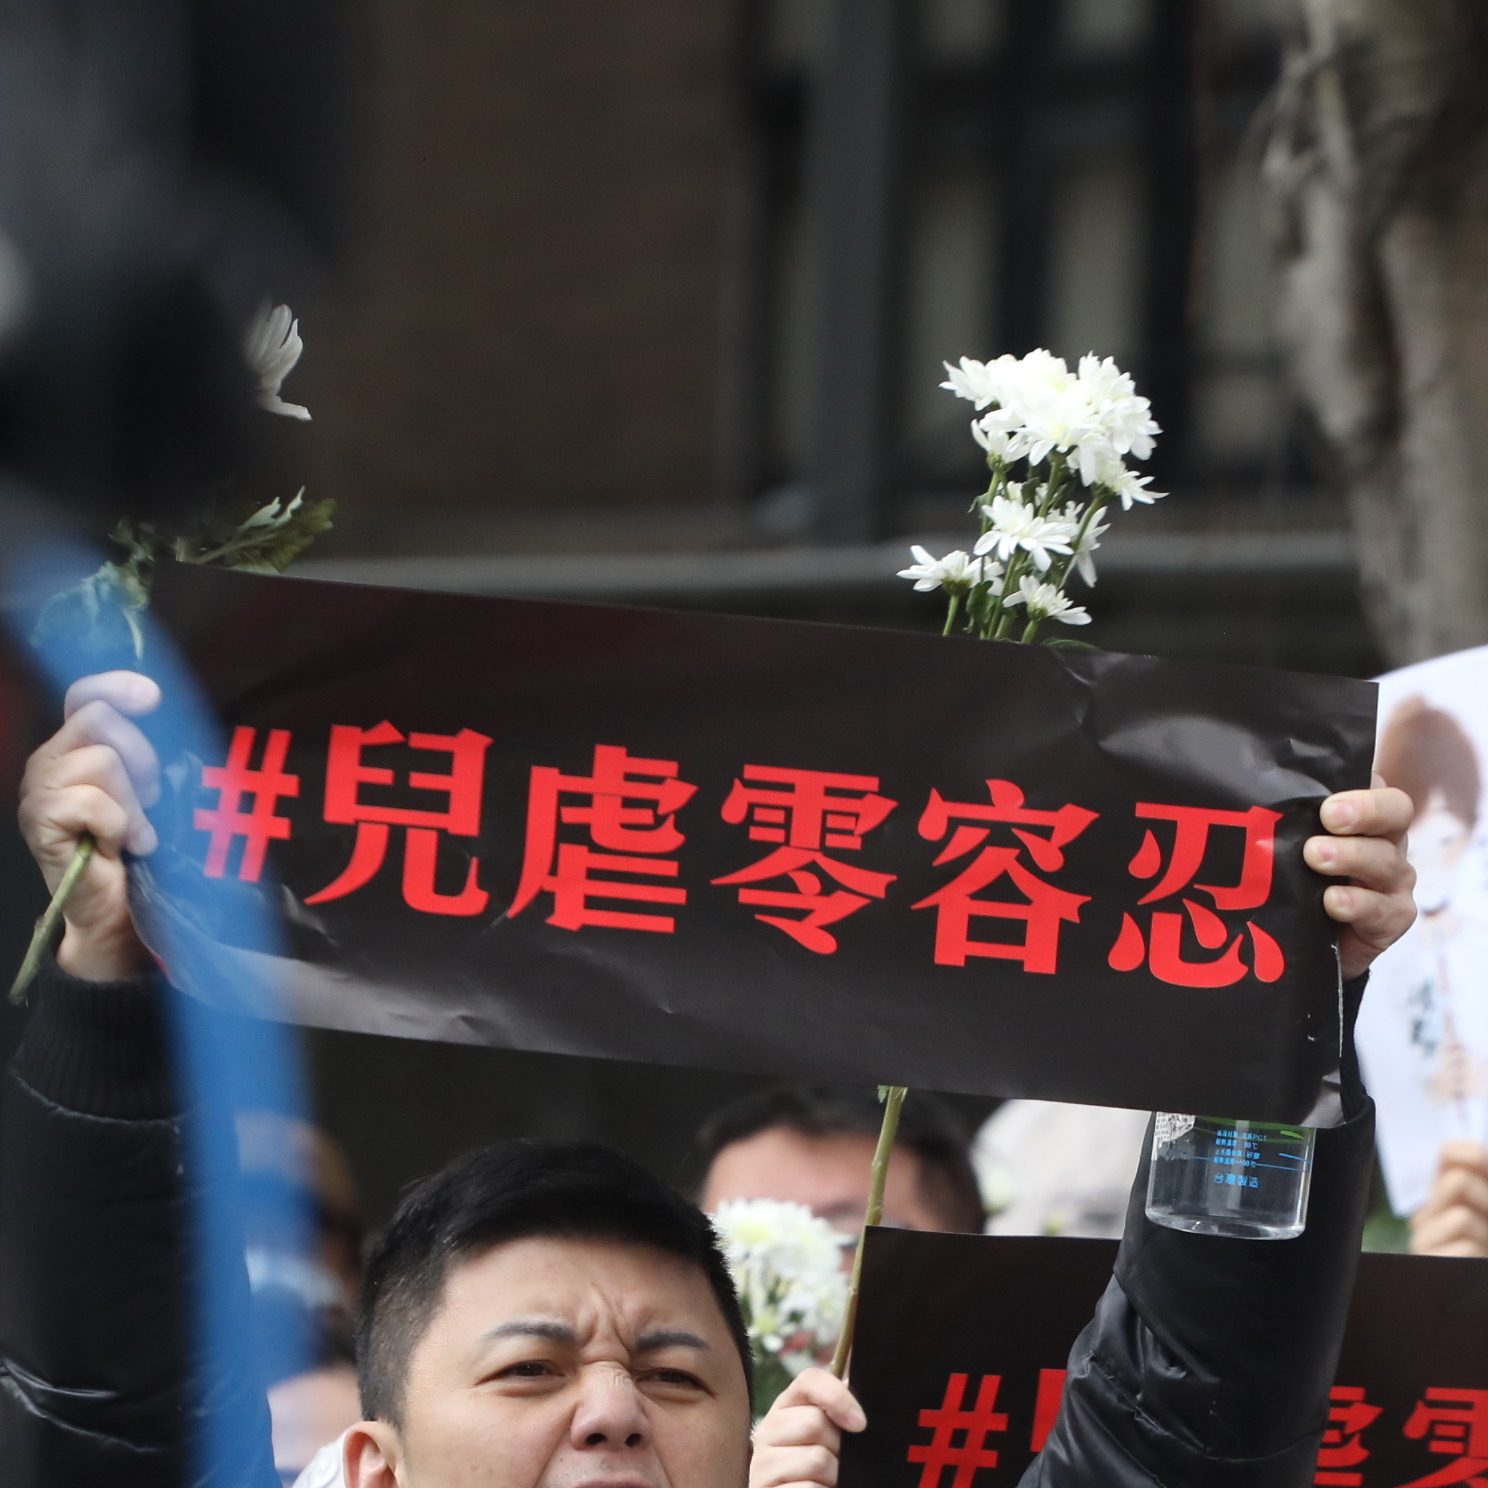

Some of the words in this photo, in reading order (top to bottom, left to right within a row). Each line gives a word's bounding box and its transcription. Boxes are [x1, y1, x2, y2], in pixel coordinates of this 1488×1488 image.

[192, 720, 1286, 989] #兒虐零容忍
